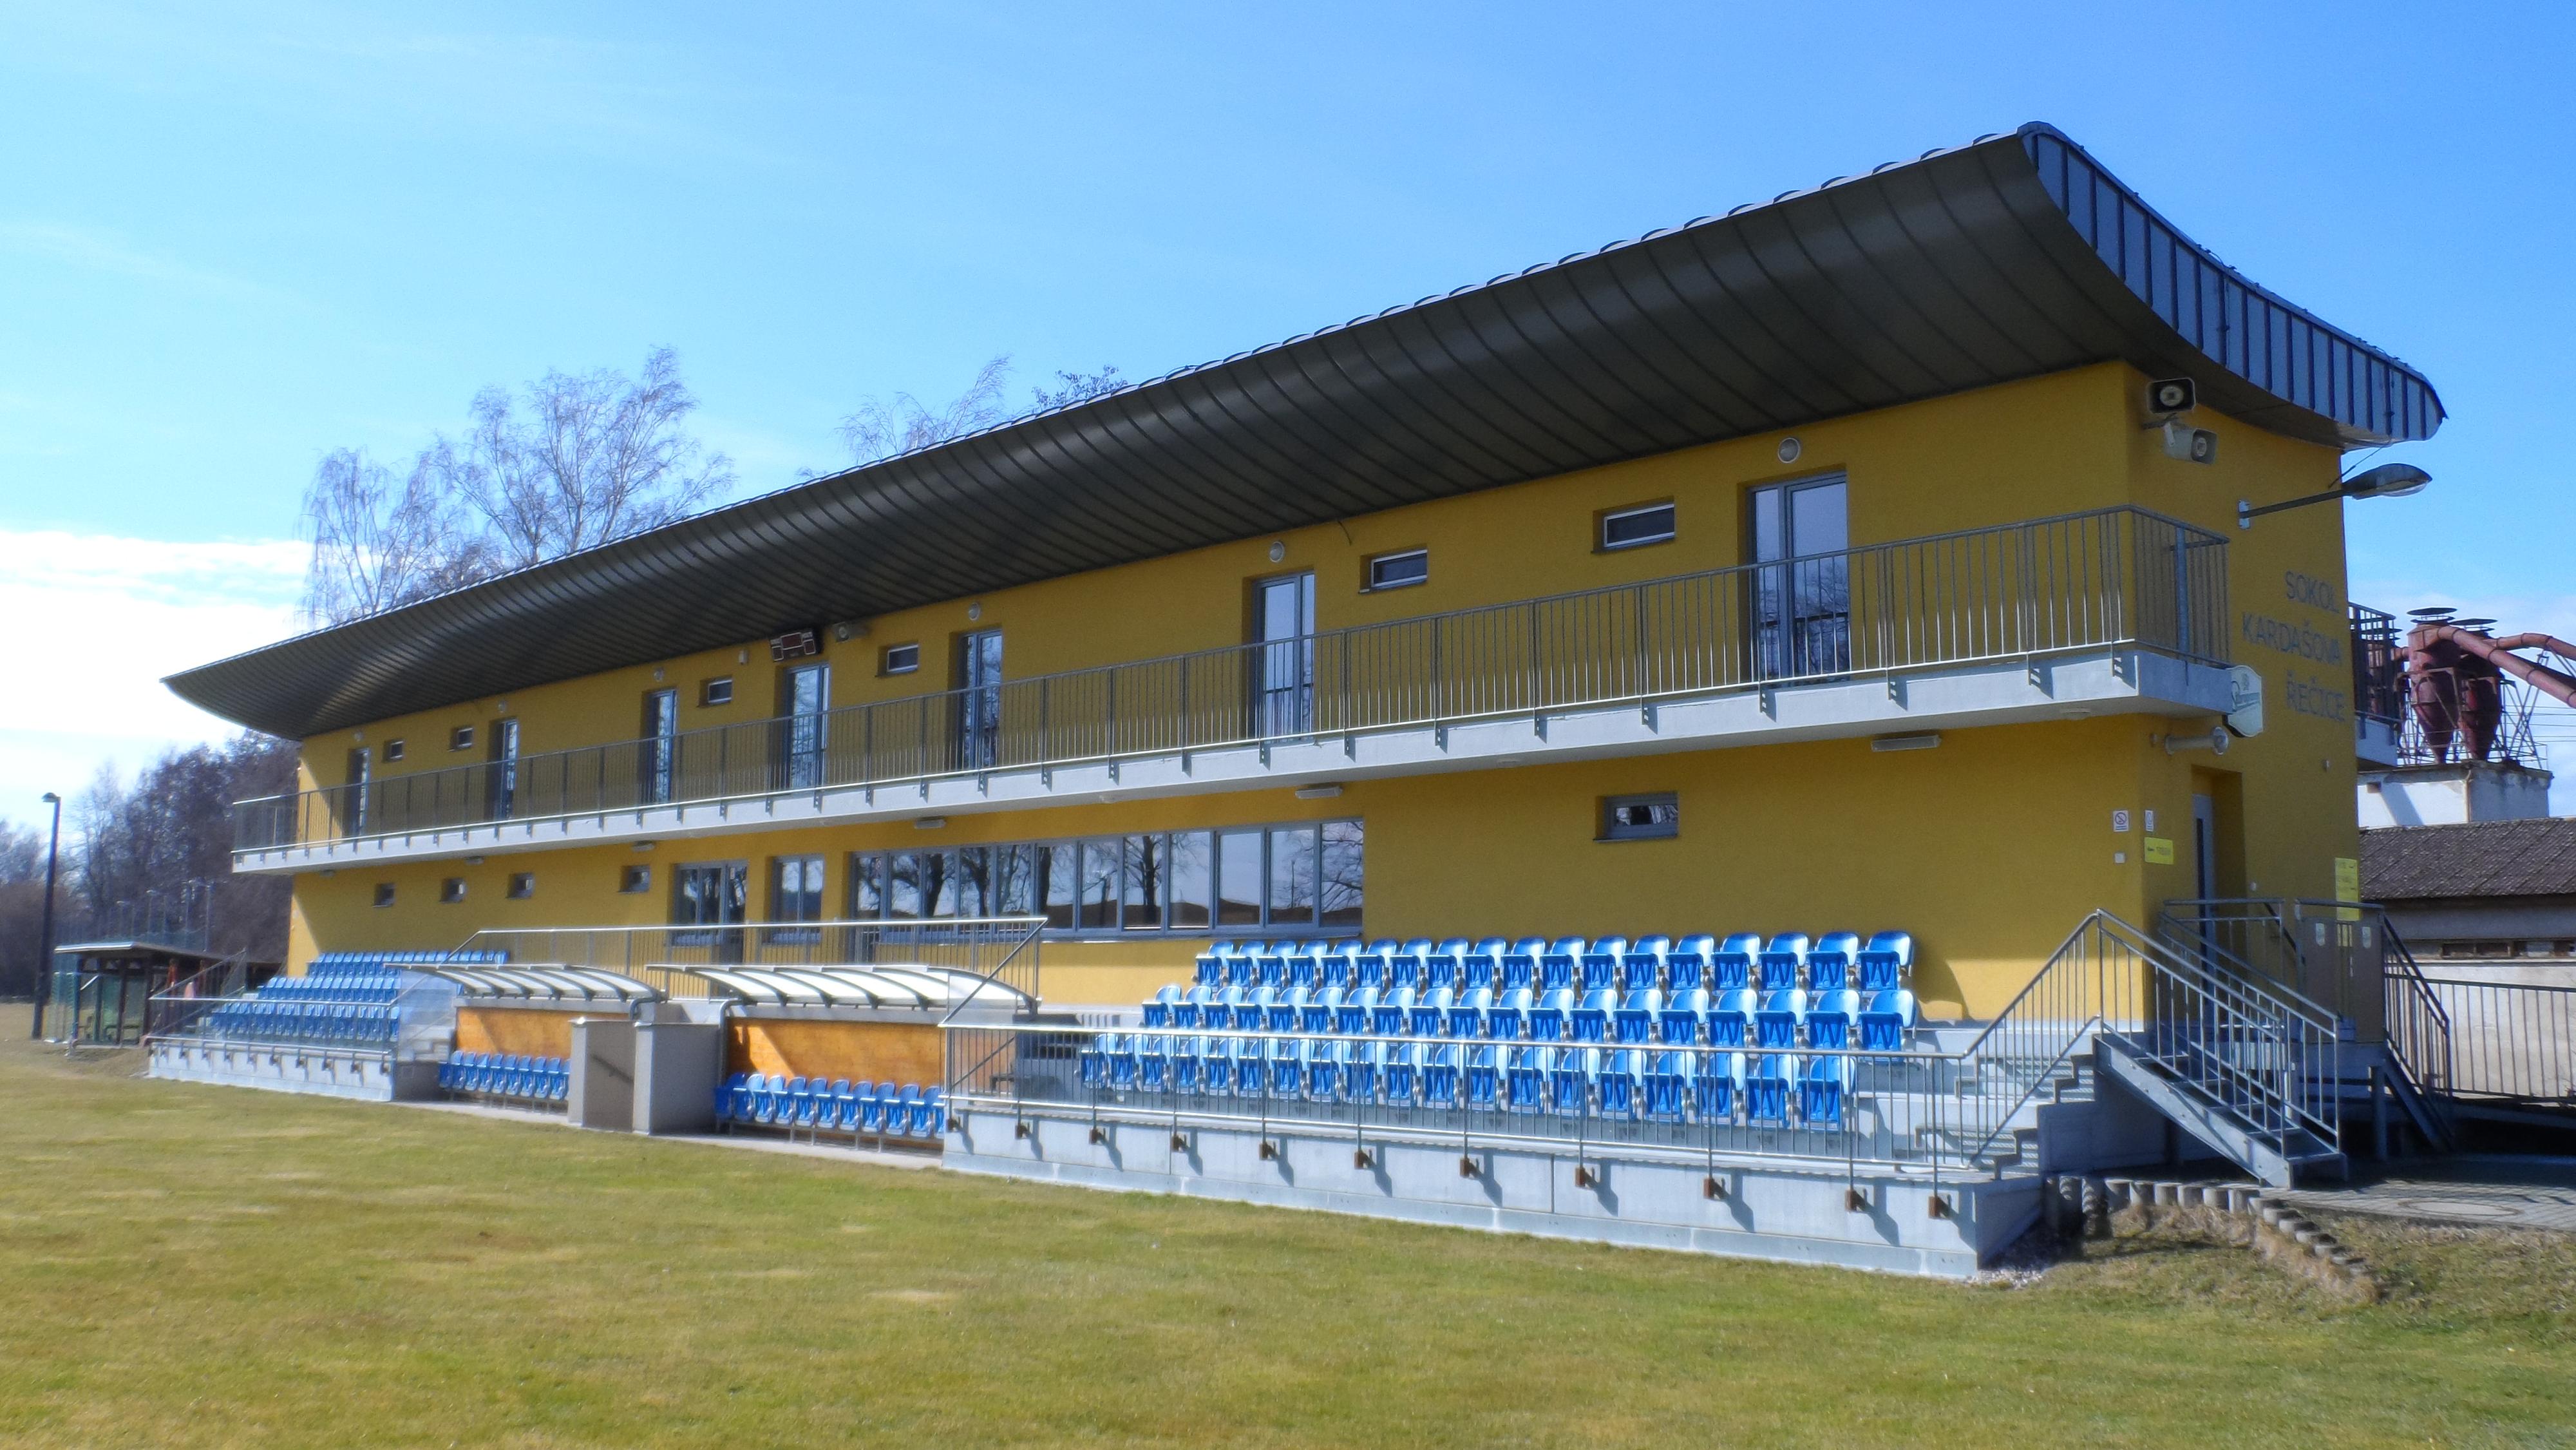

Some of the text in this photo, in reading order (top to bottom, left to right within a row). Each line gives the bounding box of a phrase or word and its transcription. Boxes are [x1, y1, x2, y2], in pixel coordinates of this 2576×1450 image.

[2286, 571, 2340, 613] SOKOL
[2242, 612, 2341, 665] KARDAŠOVA
[2287, 670, 2345, 722] ŘEČICE
